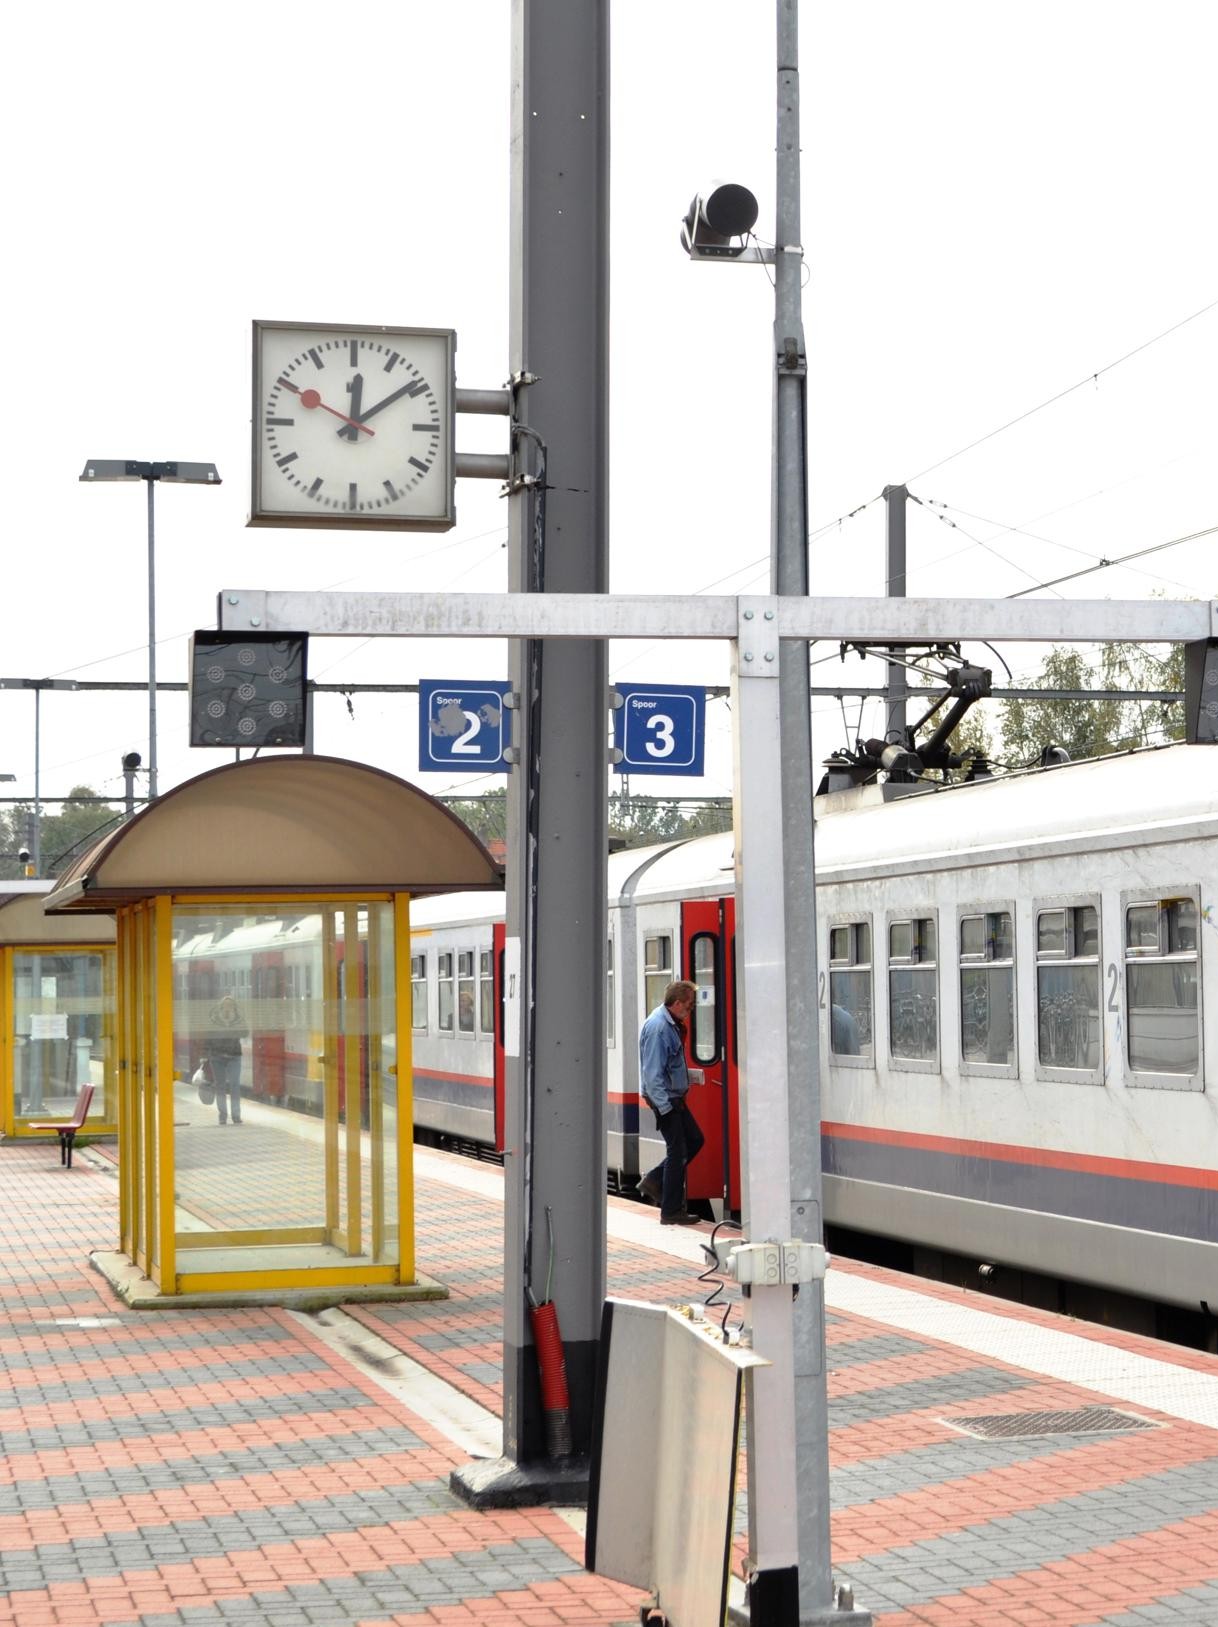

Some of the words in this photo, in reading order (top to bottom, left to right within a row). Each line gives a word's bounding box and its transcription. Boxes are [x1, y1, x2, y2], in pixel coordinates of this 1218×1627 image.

[632, 700, 657, 709] Spoor
[450, 710, 481, 754] 2
[645, 714, 675, 758] 3
[819, 971, 826, 1009] 2
[1107, 962, 1119, 1013] 2
